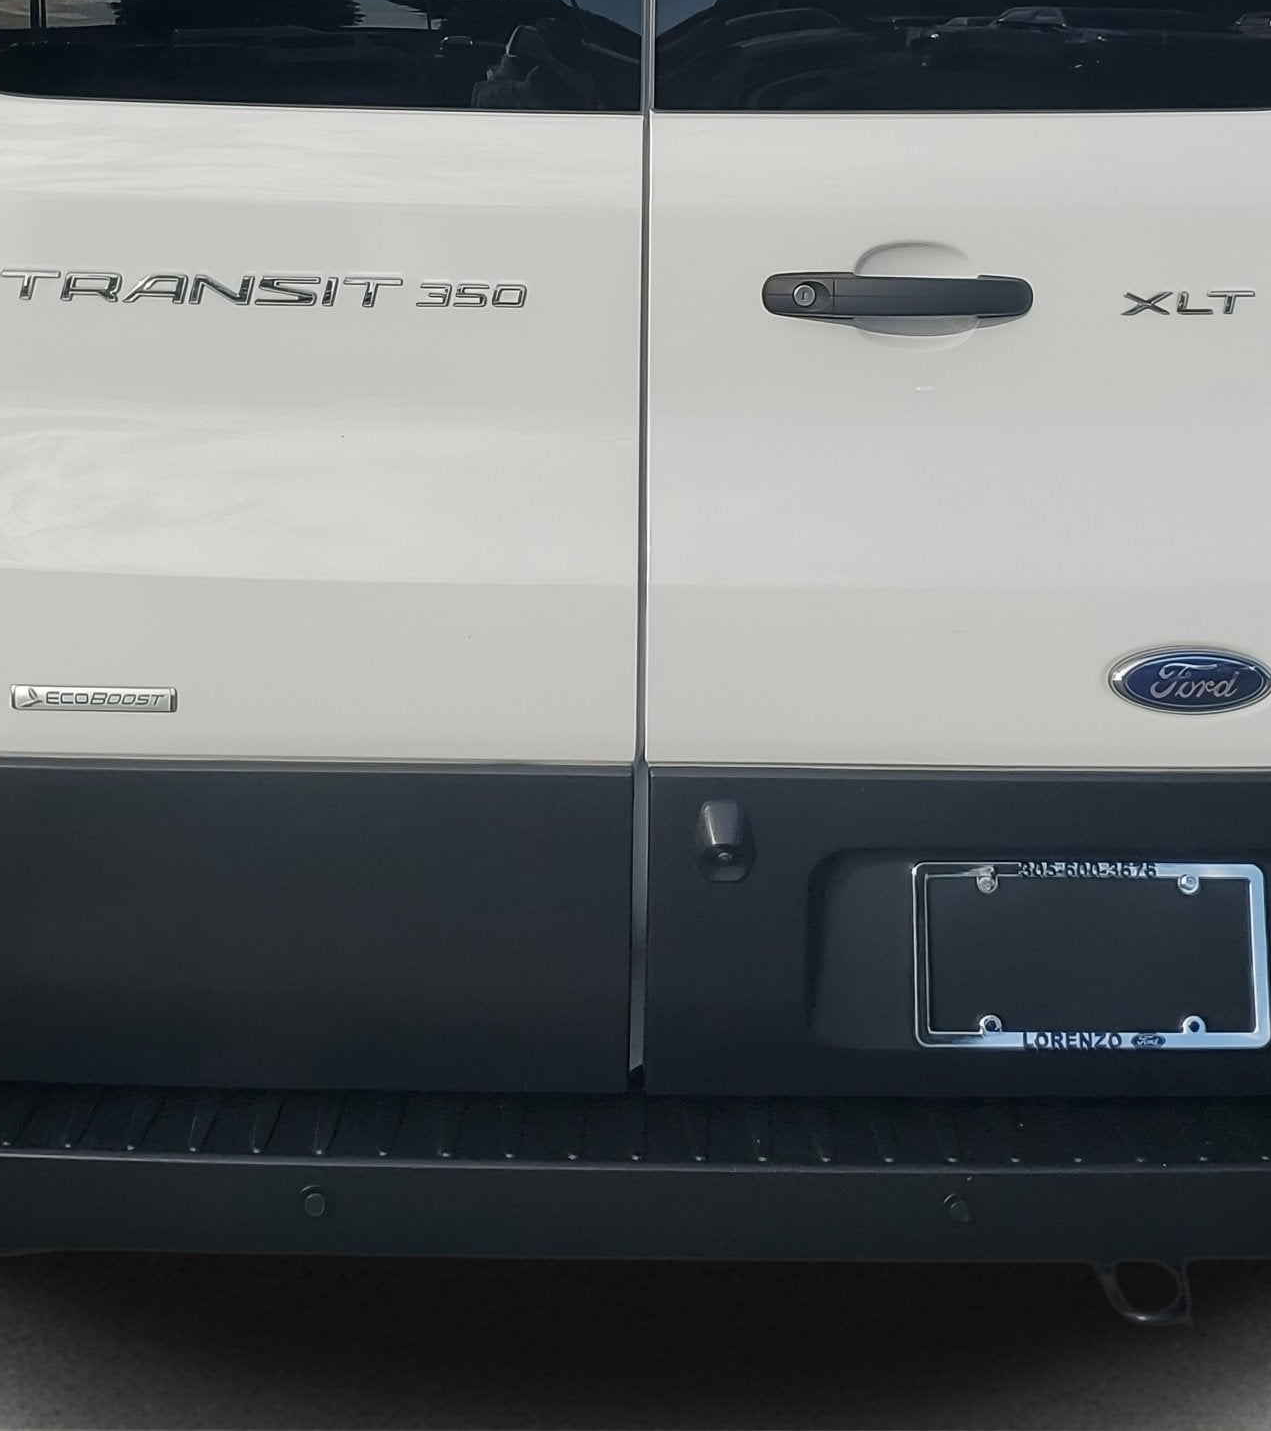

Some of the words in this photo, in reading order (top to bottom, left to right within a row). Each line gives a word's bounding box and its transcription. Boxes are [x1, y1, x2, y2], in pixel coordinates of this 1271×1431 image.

[0, 269, 404, 308] TRANSIT
[415, 280, 528, 309] 350
[1120, 290, 1256, 316] XLT
[1149, 662, 1240, 699] Ford
[1022, 1031, 1123, 1050] LORENZO
